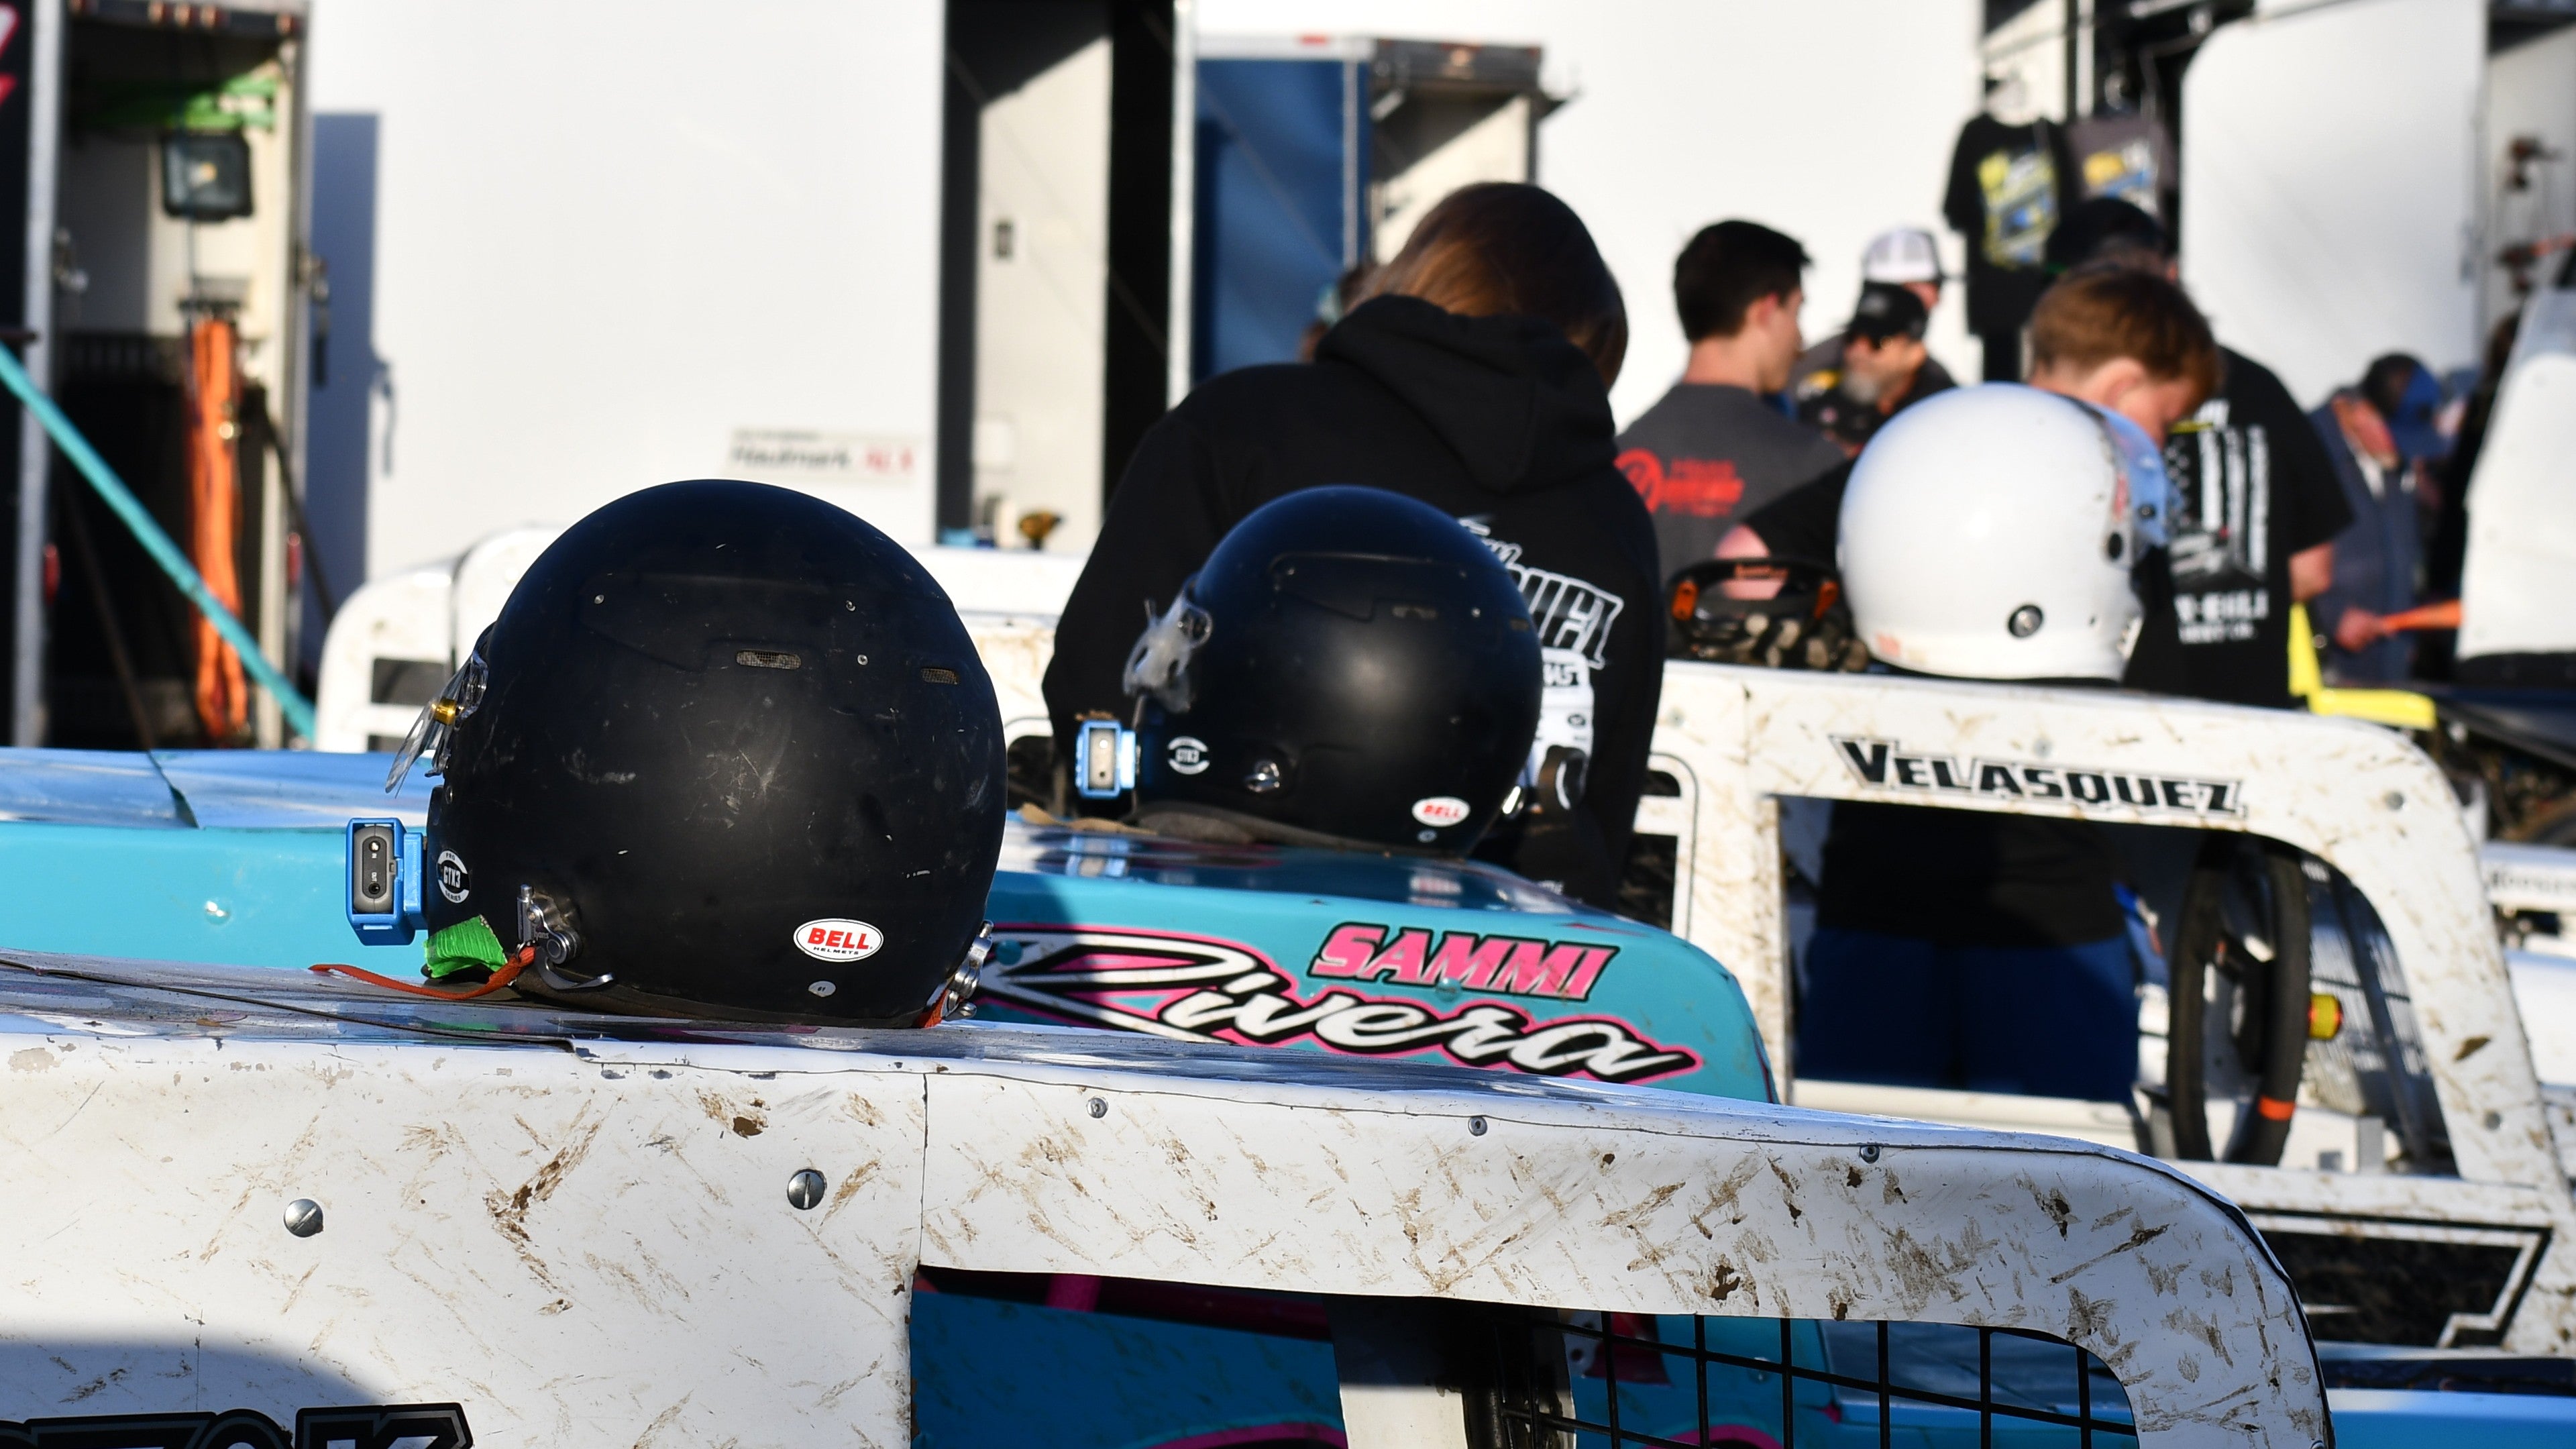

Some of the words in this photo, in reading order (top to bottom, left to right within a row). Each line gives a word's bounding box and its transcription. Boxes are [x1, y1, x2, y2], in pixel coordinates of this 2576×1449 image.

[1837, 739, 2243, 814] VELASQUEZ
[1424, 804, 1460, 819] BELL
[445, 852, 455, 861] PRO
[443, 866, 461, 889] GTX3
[444, 890, 462, 902] SERIES
[807, 927, 869, 951] BELL
[813, 946, 859, 955] HELMETS
[1309, 922, 1619, 1001] SAMMI
[976, 928, 1701, 1082] Rivera
